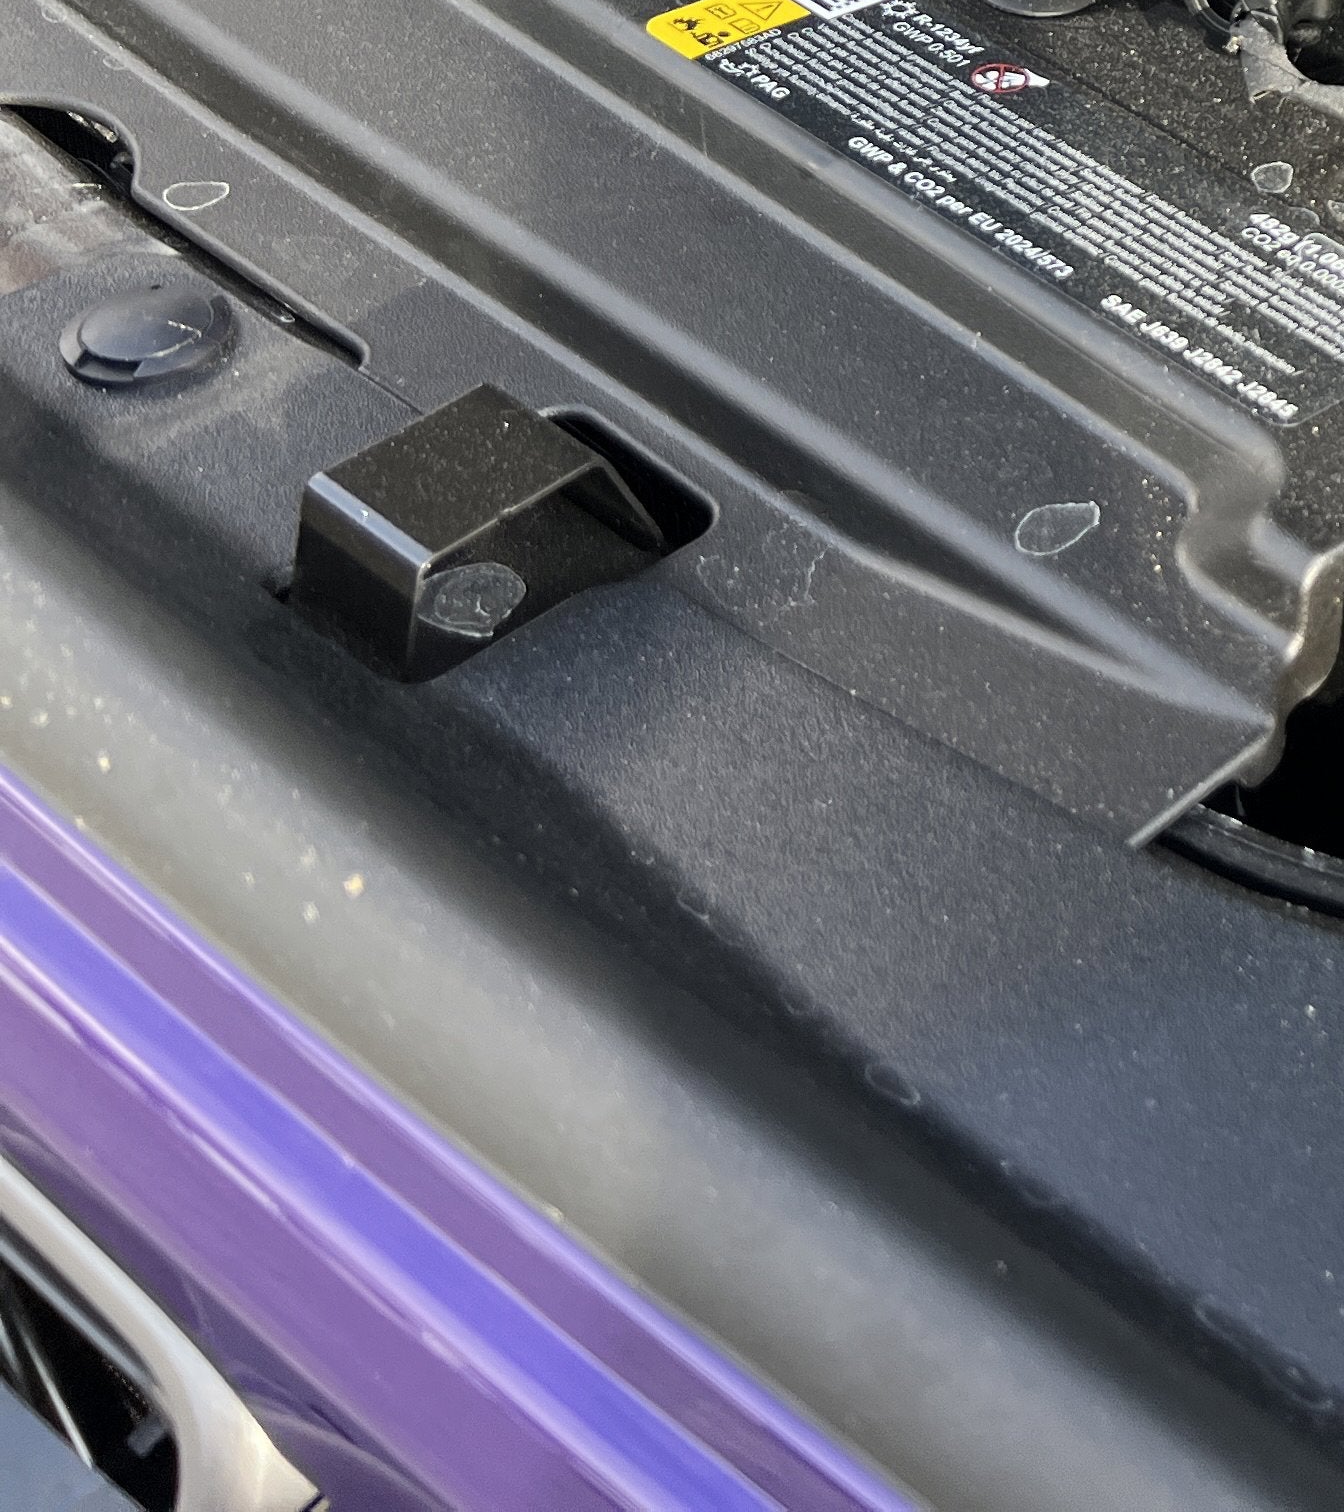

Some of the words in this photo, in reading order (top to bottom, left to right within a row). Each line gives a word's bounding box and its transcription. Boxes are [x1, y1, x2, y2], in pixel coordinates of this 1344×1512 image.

[892, 21, 933, 43] GWP
[927, 42, 970, 67] 0.501
[912, 13, 984, 53] R-1234yf
[750, 74, 790, 98] PAG
[848, 136, 893, 162] GWP
[887, 161, 907, 175] &
[903, 171, 945, 198] CO2
[935, 195, 973, 214] per
[968, 211, 1002, 231] EU
[994, 228, 1073, 278] 2024/573
[1240, 227, 1283, 251] CO2
[1249, 213, 1299, 245] 482g
[1100, 294, 1146, 324] SAE
[1139, 321, 1188, 350] J639
